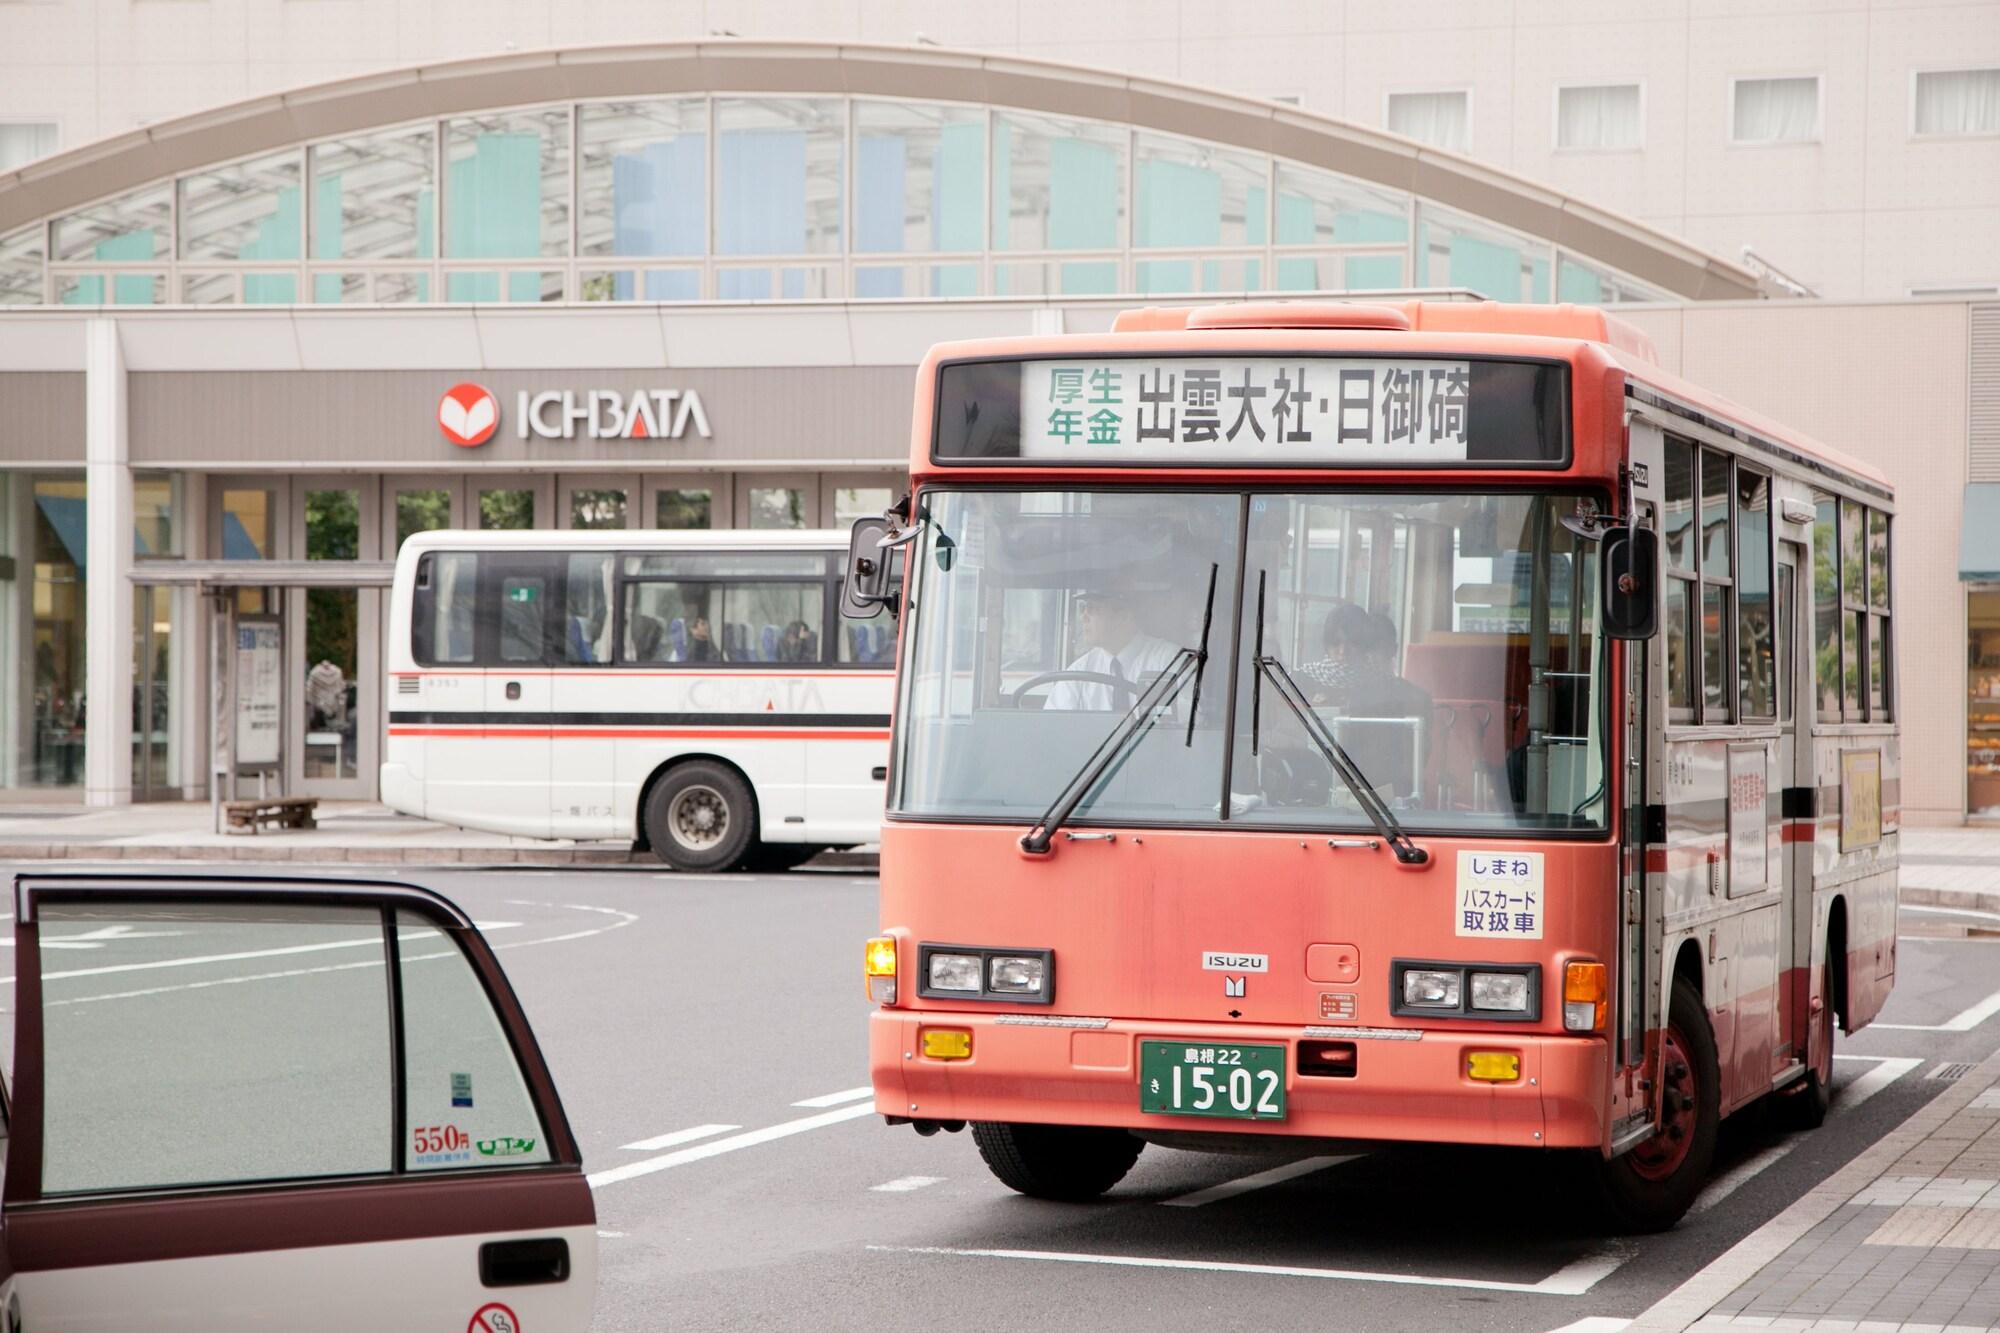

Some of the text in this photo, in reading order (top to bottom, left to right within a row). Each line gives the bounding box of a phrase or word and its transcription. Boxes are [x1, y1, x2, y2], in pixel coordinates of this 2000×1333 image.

[1048, 367, 1124, 405] 厚生
[1047, 407, 1124, 445] 年金
[1473, 858, 1529, 876] しまね
[1463, 889, 1536, 911] バスカード
[1463, 910, 1535, 933] 取扱車
[1208, 956, 1262, 968] ISUZU
[1151, 1065, 1279, 1113] き 15-02
